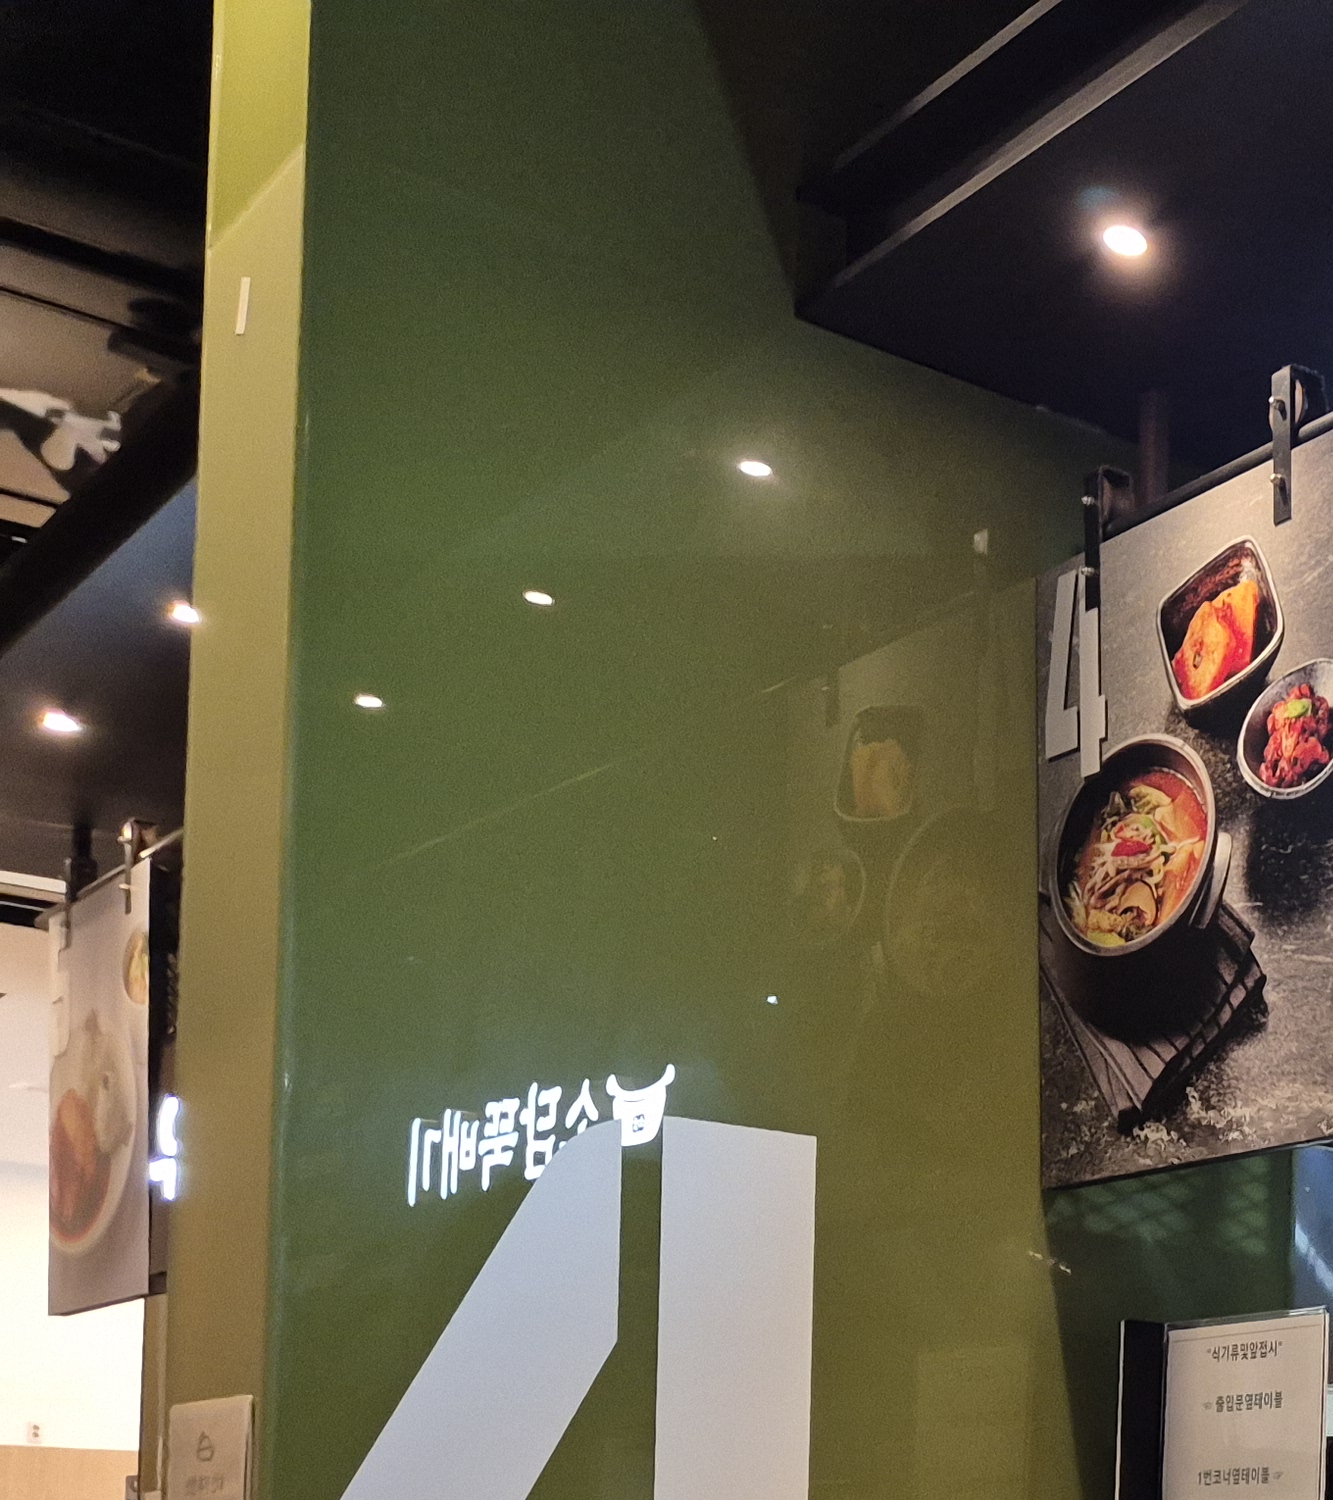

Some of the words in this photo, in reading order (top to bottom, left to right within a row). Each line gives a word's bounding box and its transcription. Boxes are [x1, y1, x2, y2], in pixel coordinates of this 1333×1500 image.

[1045, 567, 1107, 779] 4
[1215, 1390, 1283, 1413] 출입문옆테이블
[1198, 1466, 1271, 1486] 1번코너옆테이블
